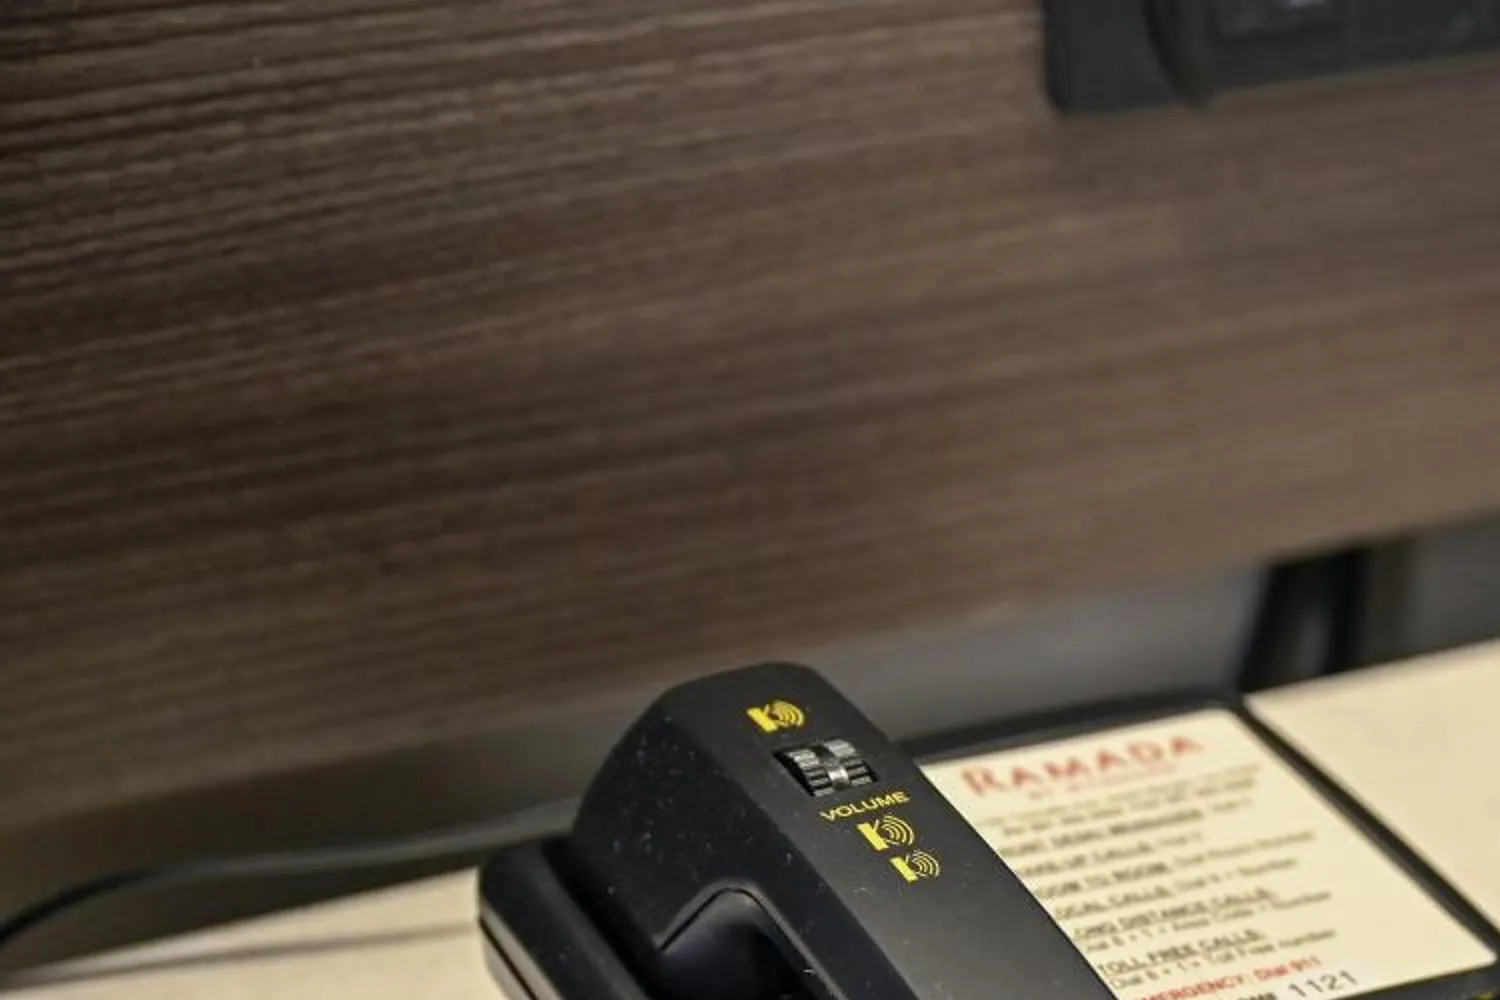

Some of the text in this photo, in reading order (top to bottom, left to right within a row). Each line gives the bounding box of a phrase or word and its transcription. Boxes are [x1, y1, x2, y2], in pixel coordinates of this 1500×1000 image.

[962, 736, 1203, 797] RAMADA
[819, 790, 910, 822] VOLUME
[1055, 901, 1108, 921] OCAL
[1075, 921, 1118, 941] ONG
[1118, 902, 1209, 930] DISTANCE
[1098, 956, 1148, 977] TOLL
[1148, 943, 1200, 962] FREE
[1252, 963, 1289, 981] Dial
[1289, 956, 1321, 972] 911
[1289, 969, 1358, 998] 1121
